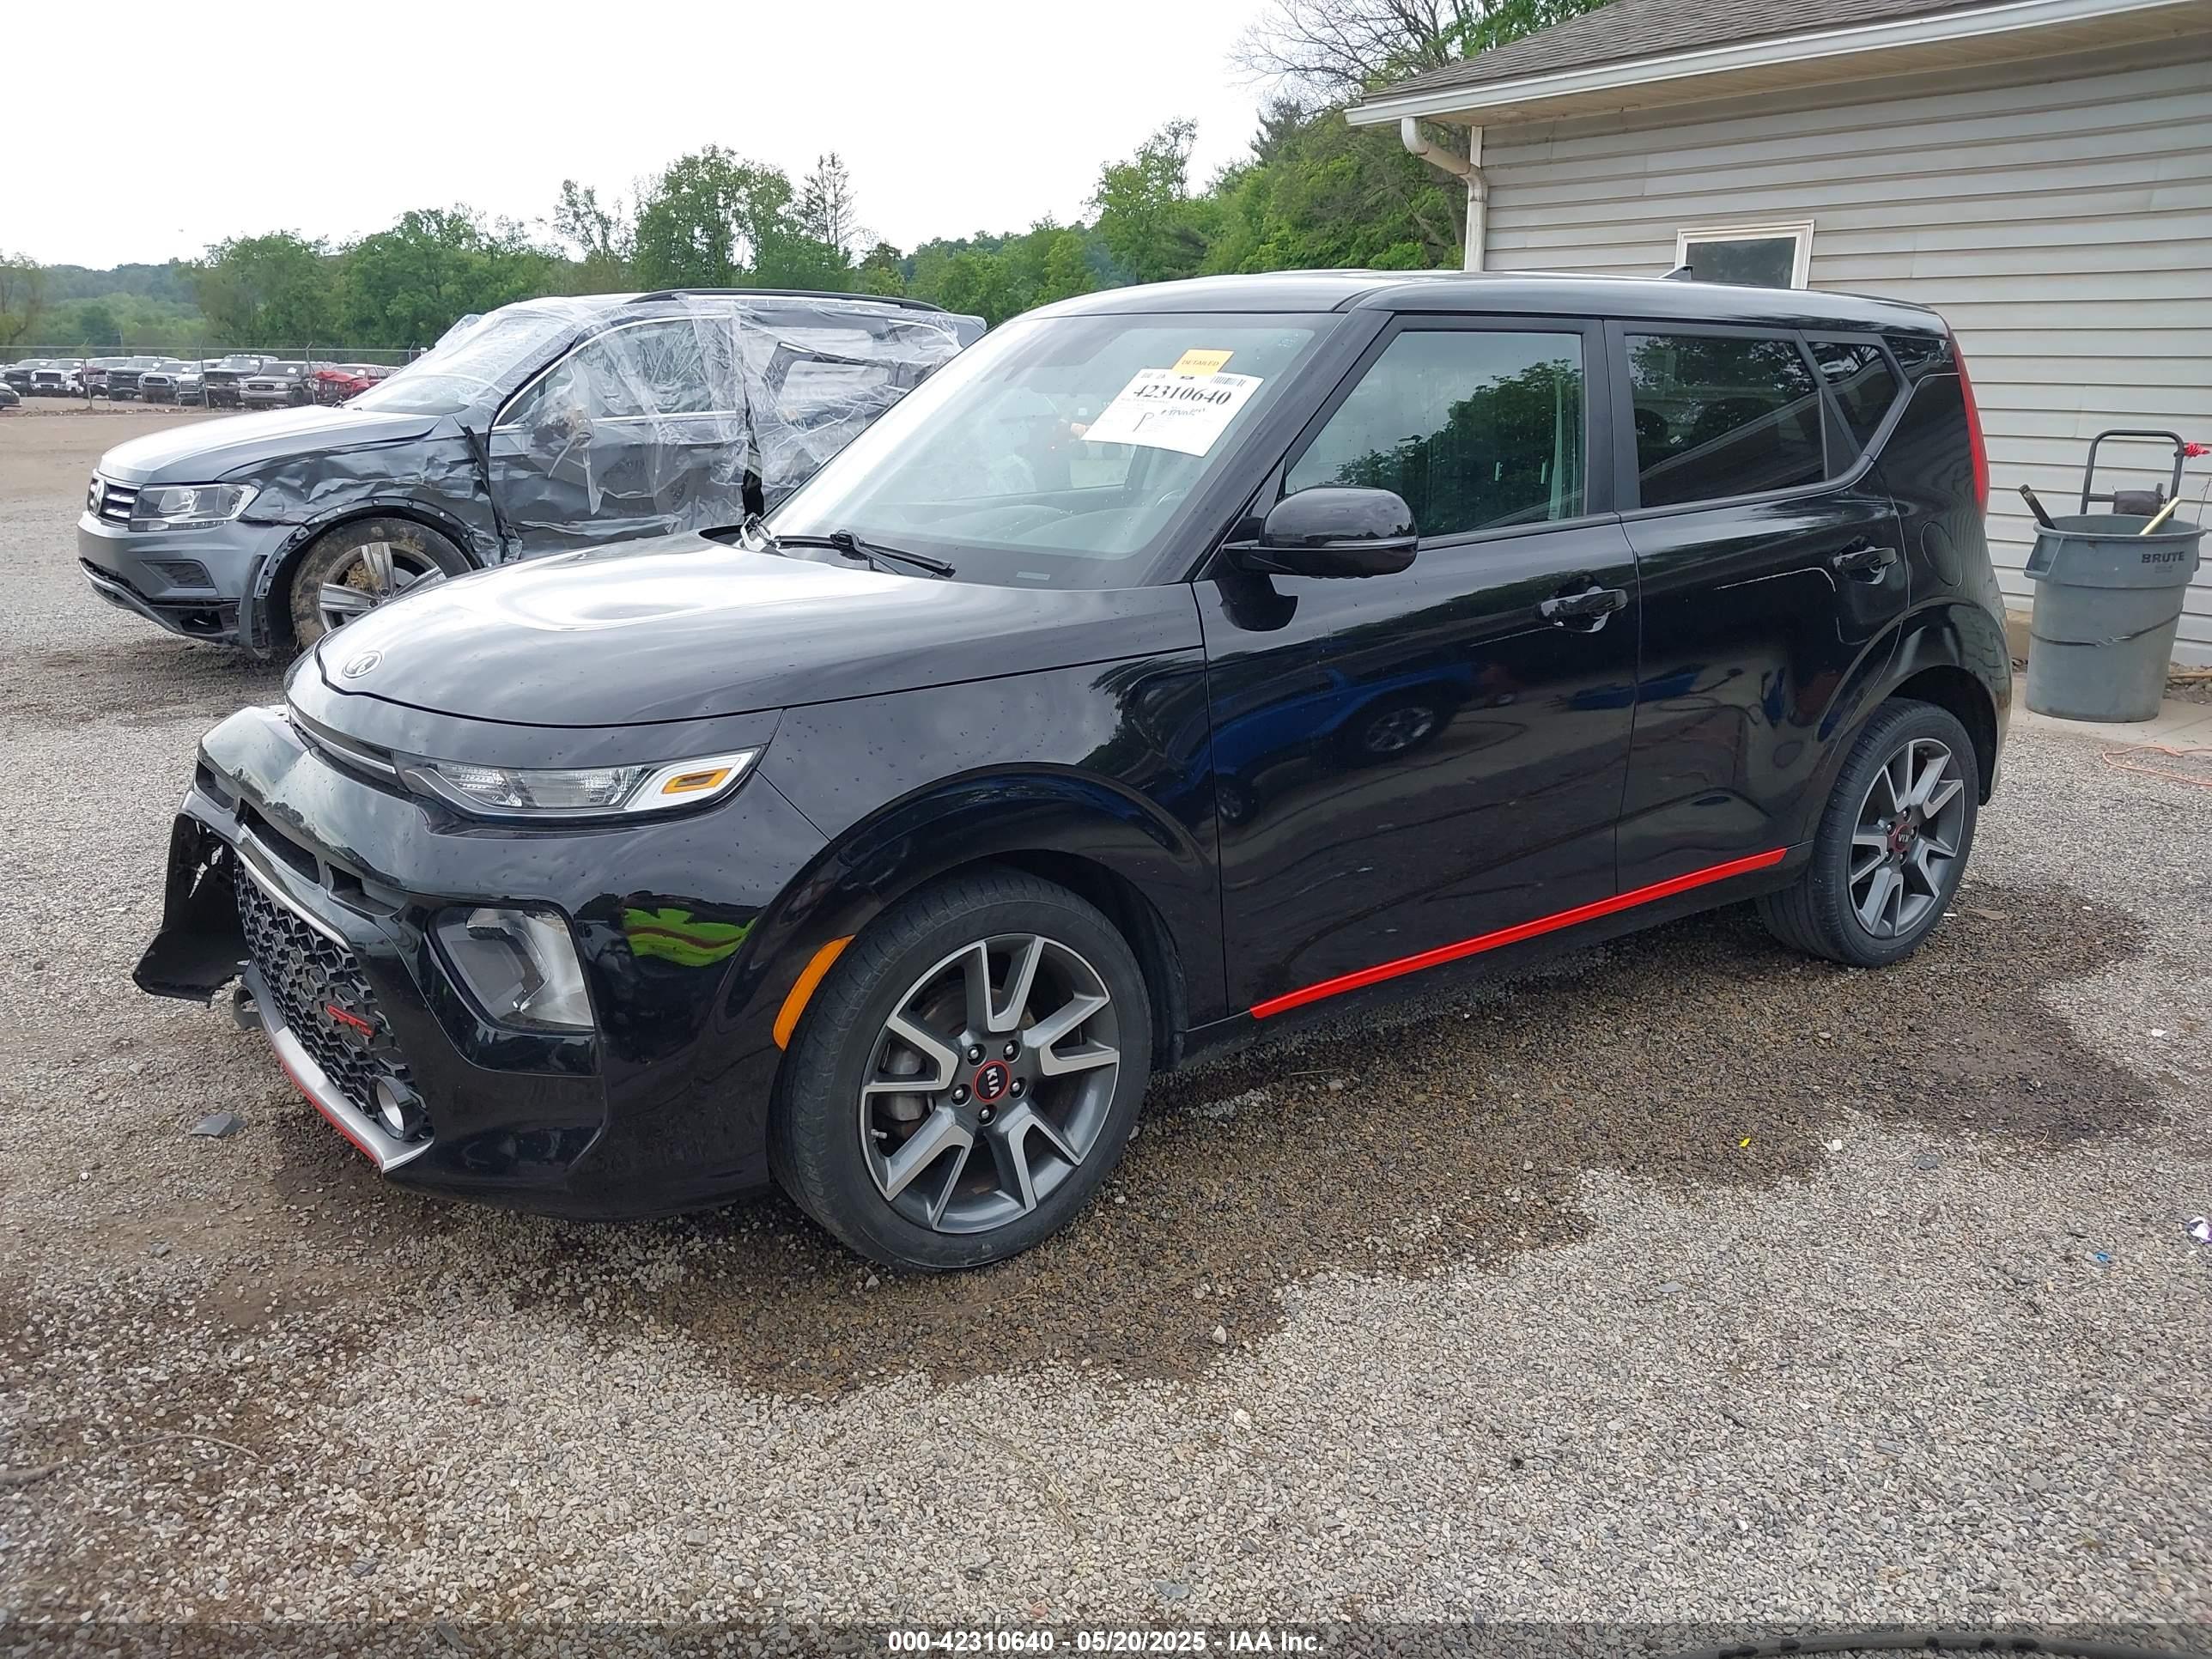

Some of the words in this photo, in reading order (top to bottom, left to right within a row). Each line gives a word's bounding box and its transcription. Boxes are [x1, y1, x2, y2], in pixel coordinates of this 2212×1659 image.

[1133, 385, 1232, 404] 42310640
[2142, 550, 2185, 563] BRUTE
[987, 1066, 1000, 1097] KIA
